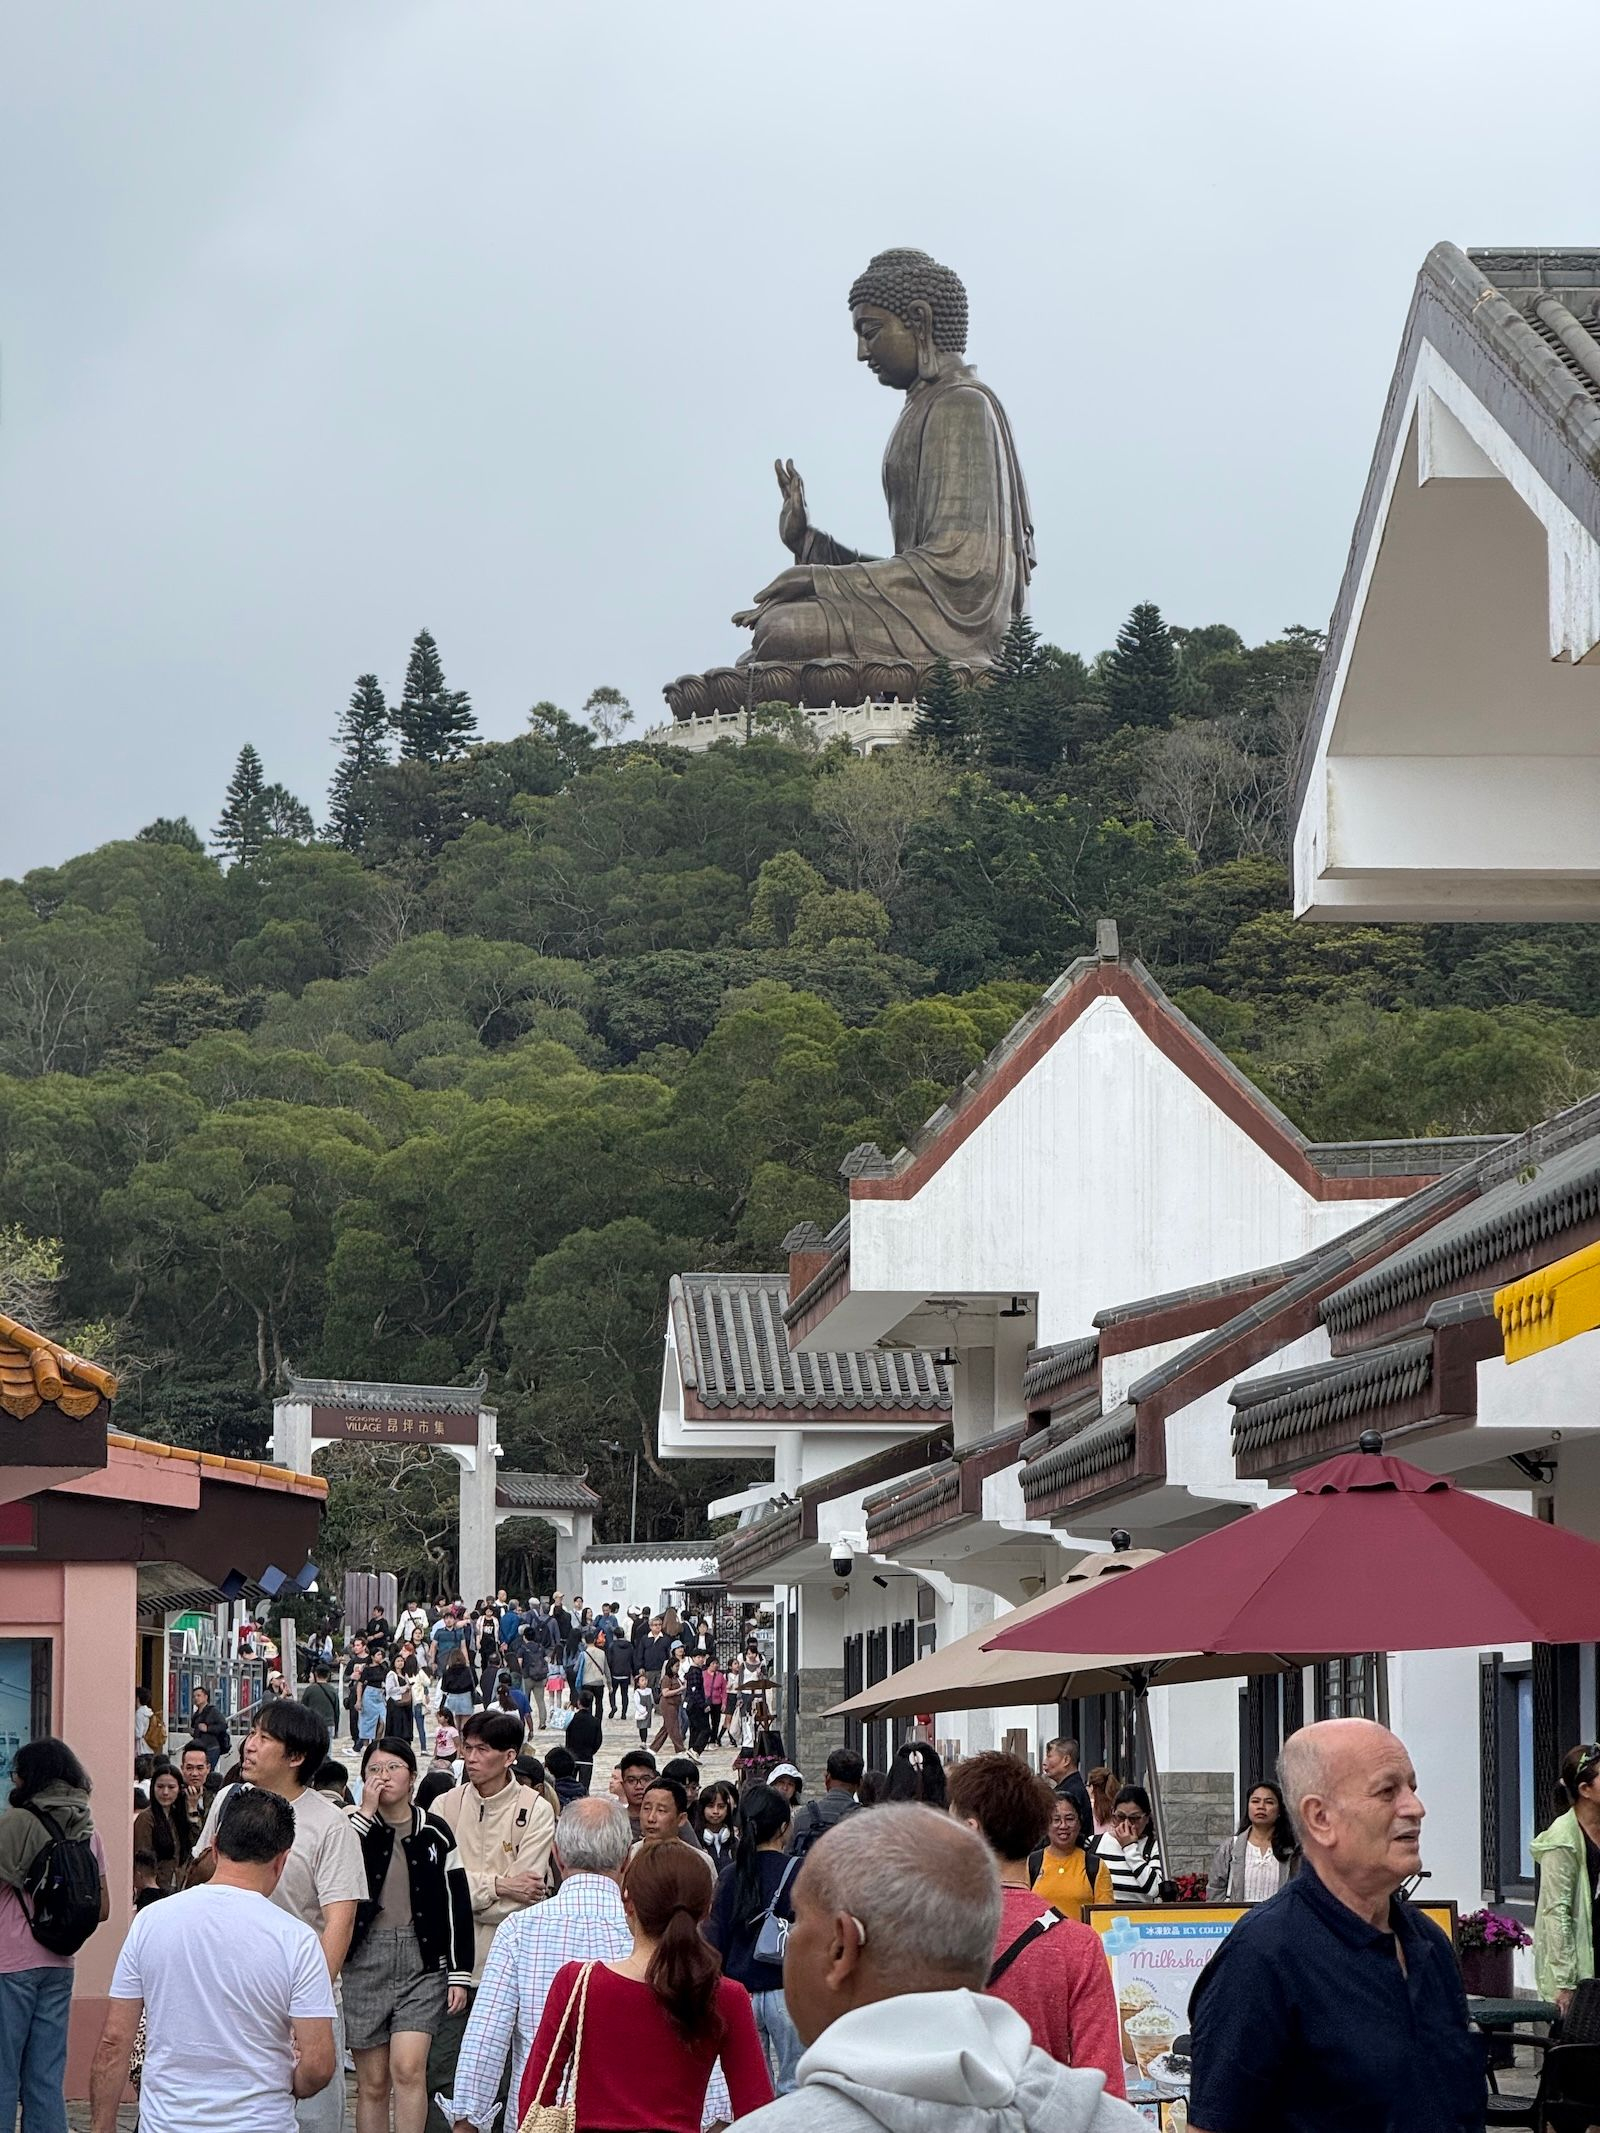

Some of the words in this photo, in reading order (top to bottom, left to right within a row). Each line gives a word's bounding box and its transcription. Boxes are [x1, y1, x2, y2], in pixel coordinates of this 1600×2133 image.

[345, 1422, 382, 1433] VILLAGE
[387, 1418, 445, 1435] 昂坪市集
[1183, 1926, 1197, 1935] ICY
[1199, 1926, 1223, 1935] COLD
